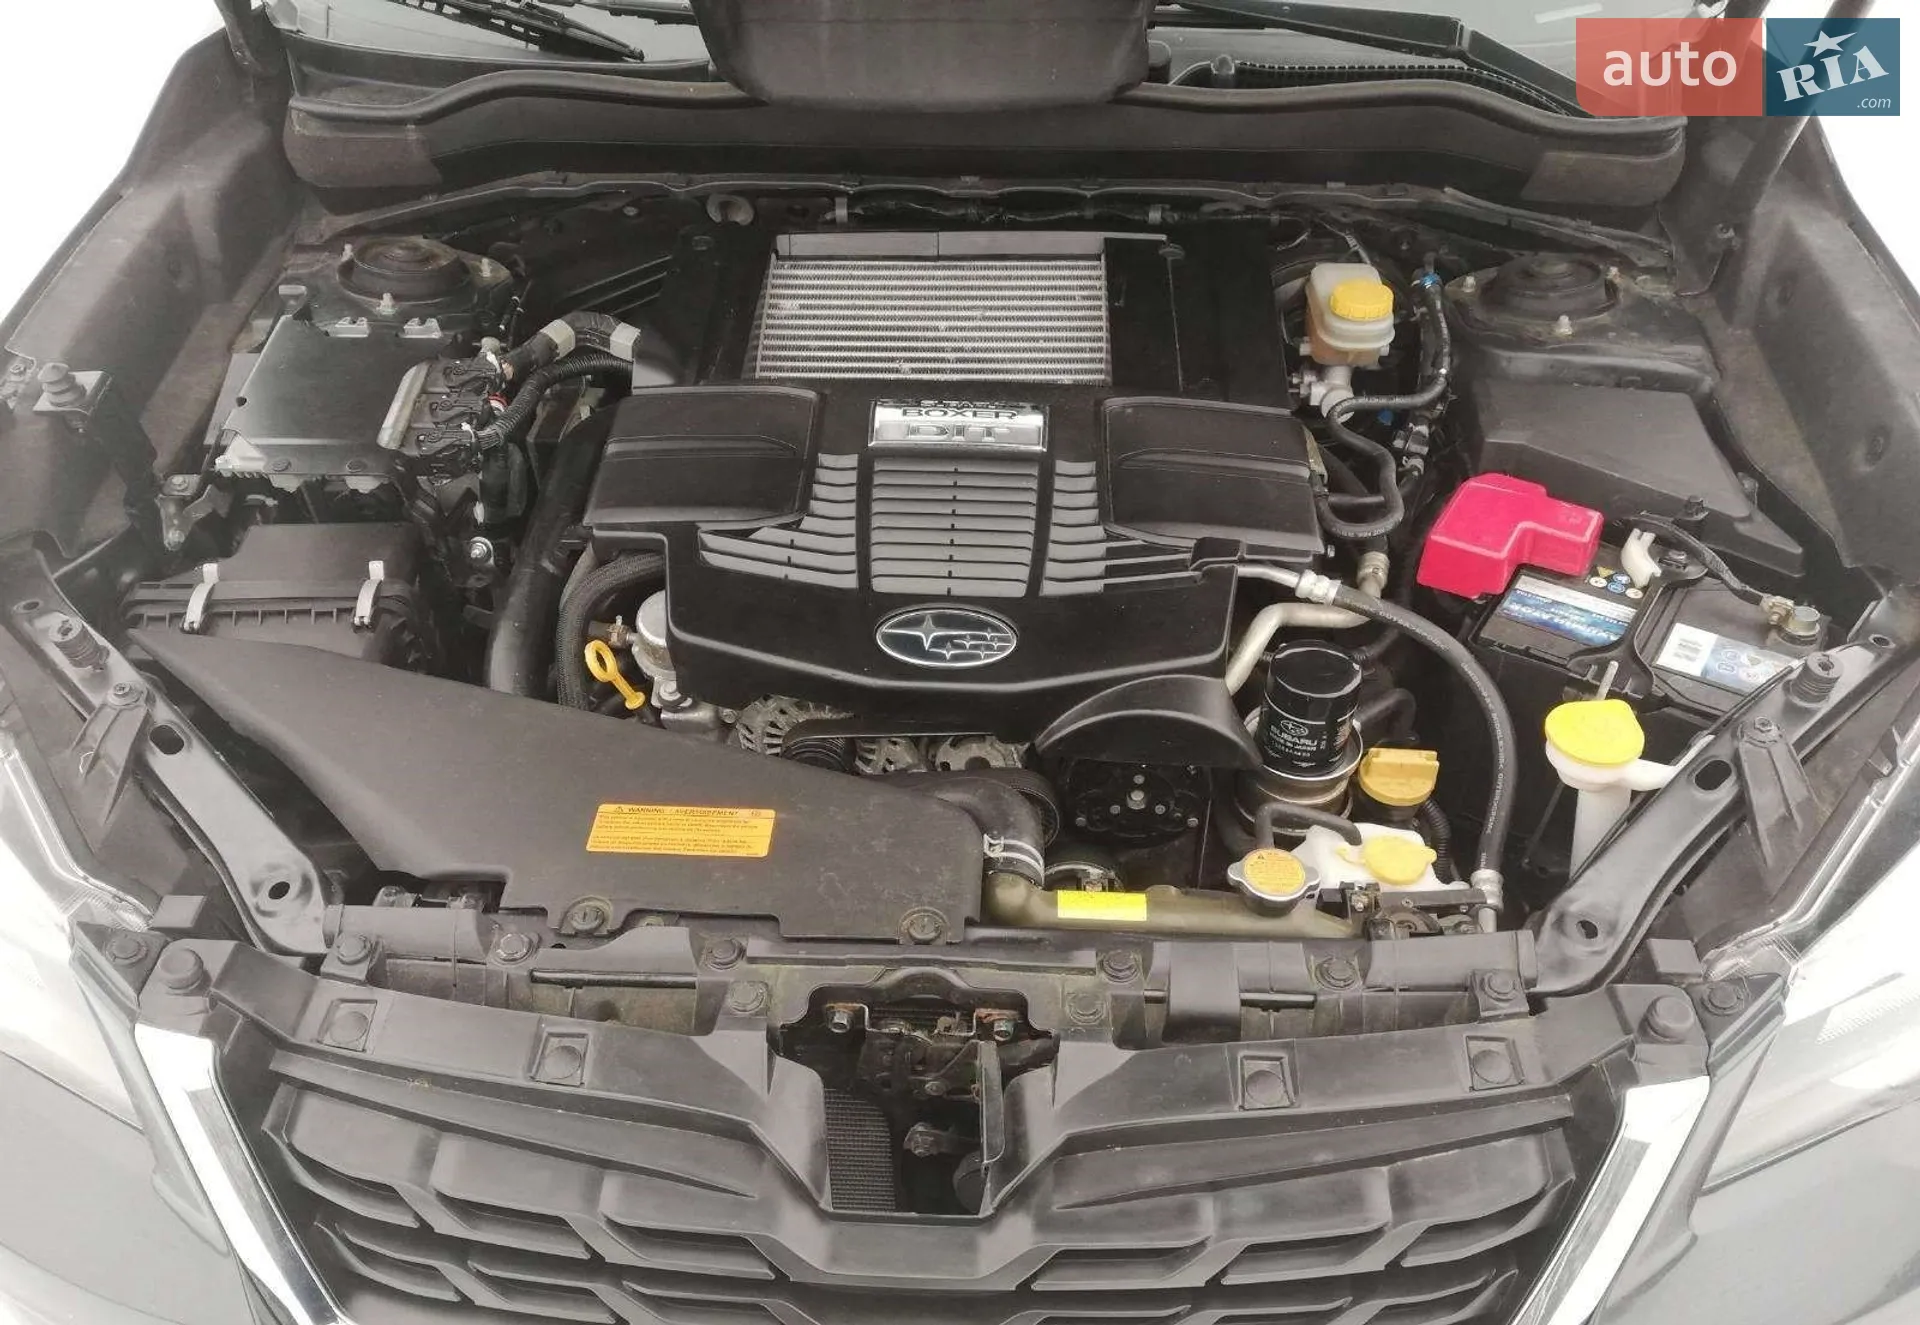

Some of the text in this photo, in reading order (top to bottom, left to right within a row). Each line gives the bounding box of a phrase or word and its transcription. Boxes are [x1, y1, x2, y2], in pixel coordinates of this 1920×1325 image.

[902, 407, 1018, 419] BOXER
[908, 423, 1010, 442] DIT
[1270, 725, 1318, 746] SUBARU
[628, 806, 665, 814] WARNING
